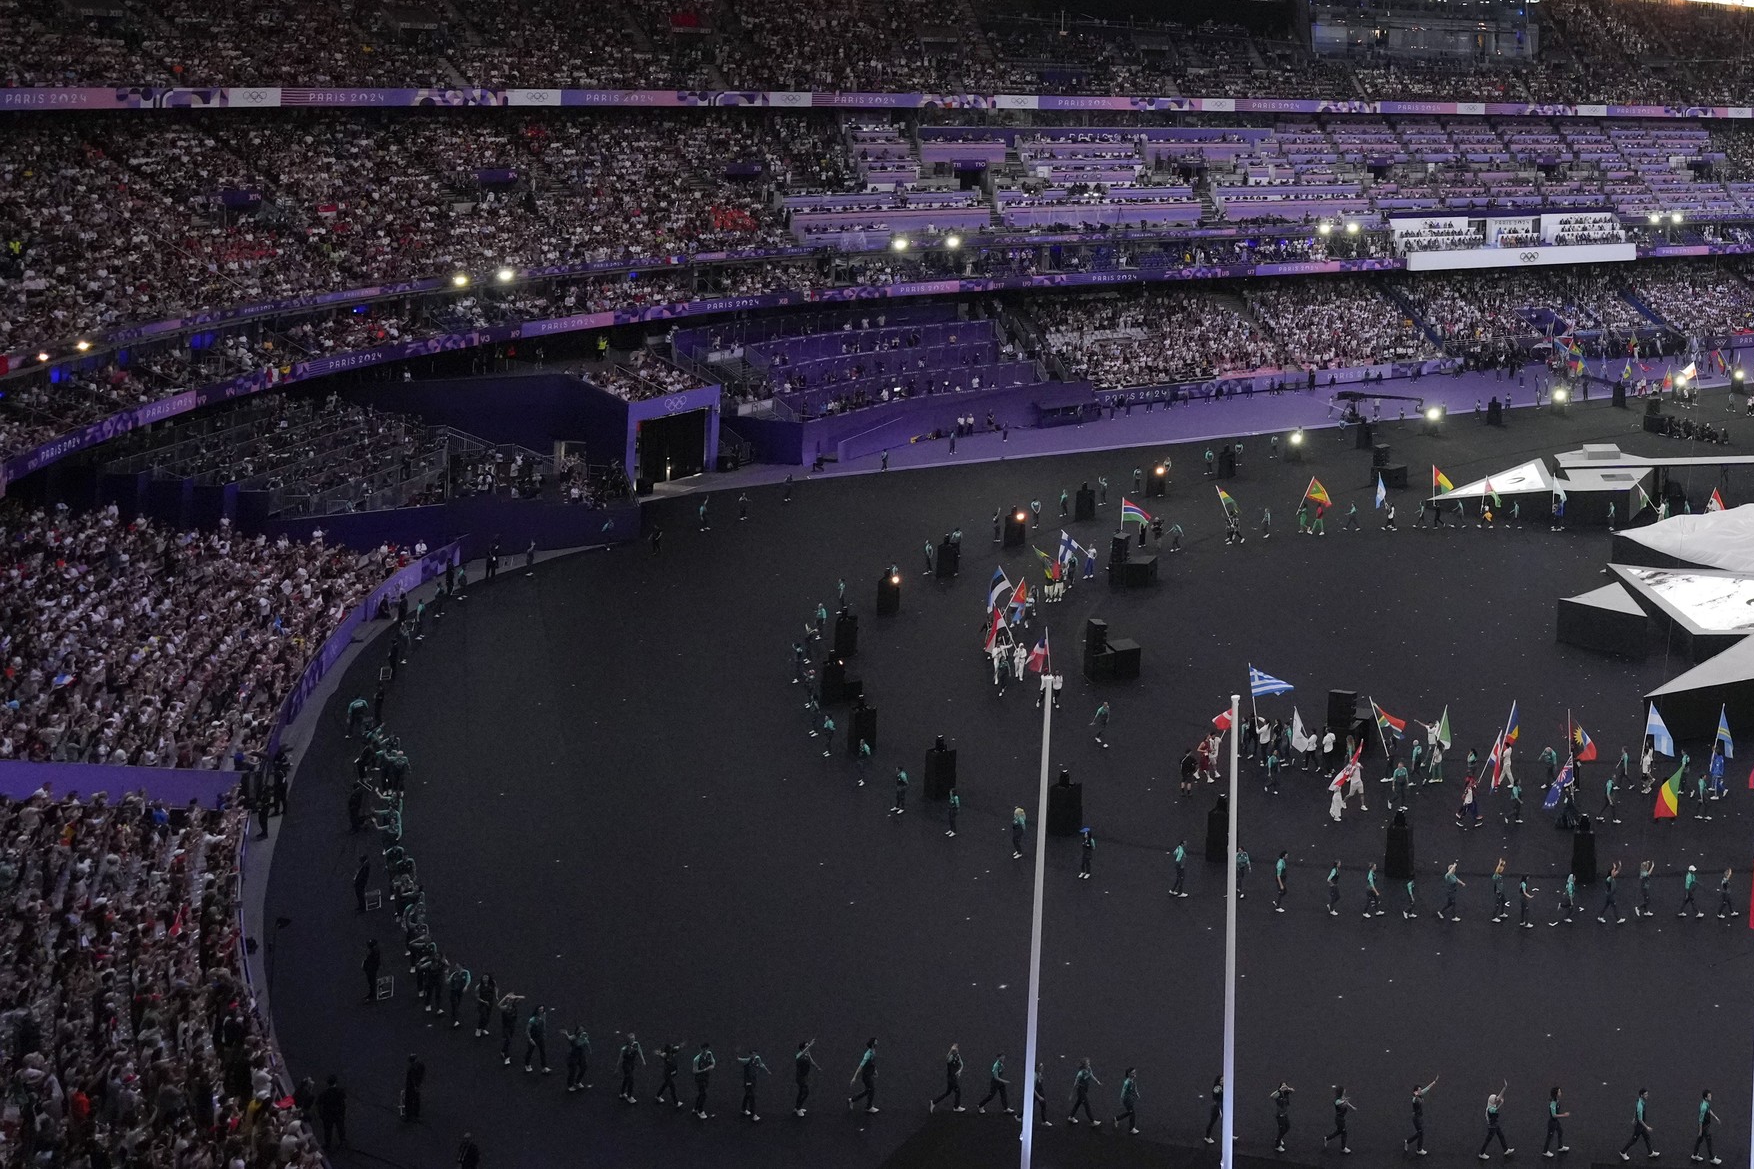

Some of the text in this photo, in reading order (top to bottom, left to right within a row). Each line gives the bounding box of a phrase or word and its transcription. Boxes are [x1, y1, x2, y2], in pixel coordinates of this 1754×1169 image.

[6, 93, 87, 103] PARIS 2024
[309, 93, 384, 102] PARIS 2024
[586, 94, 654, 102] PARIS 2024
[900, 285, 925, 293] PARIS
[707, 299, 759, 310] PARIS 2024
[542, 318, 595, 331] PARIS 2024
[329, 352, 382, 369] PARIS 2024
[1328, 371, 1354, 380] PARIS
[146, 397, 193, 418] PARIS 2024
[41, 436, 81, 462] PARIS 2024
